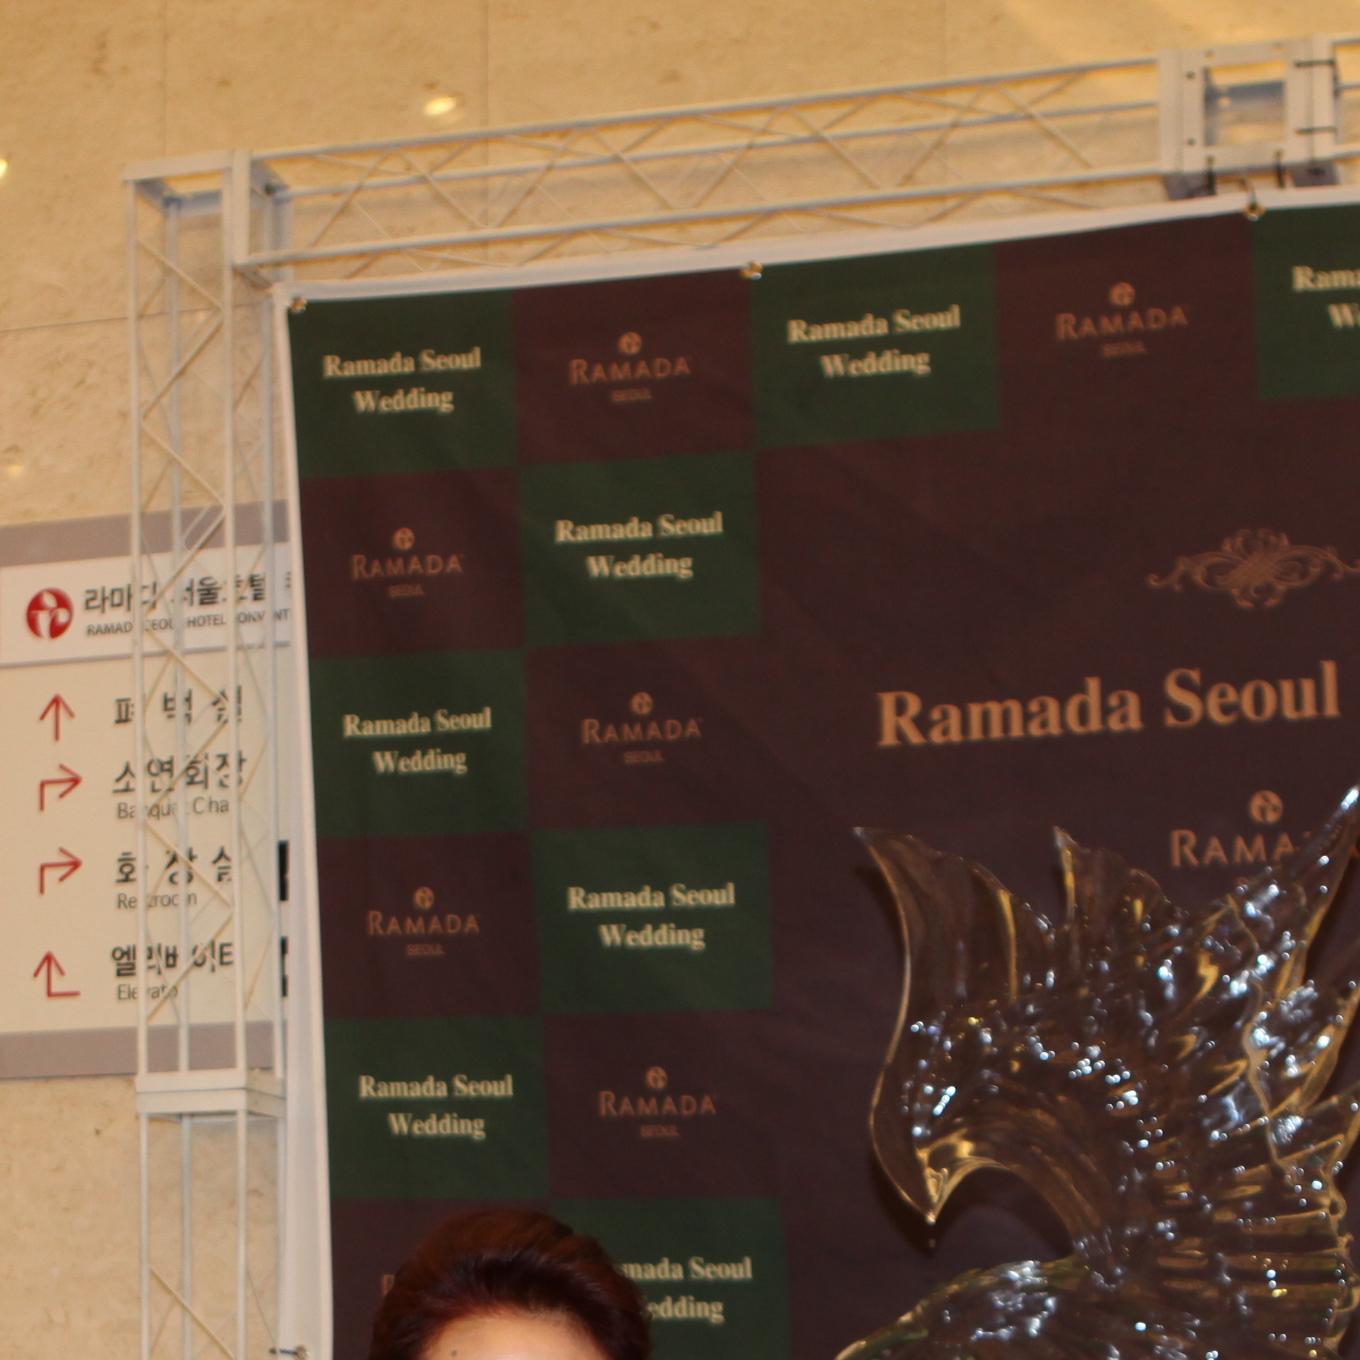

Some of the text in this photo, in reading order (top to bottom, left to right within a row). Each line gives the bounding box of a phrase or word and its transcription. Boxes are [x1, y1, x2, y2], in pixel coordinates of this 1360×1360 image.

[788, 305, 960, 343] Ramada Seoul
[1056, 306, 1187, 340] RAMADA
[324, 347, 481, 377] Ramada Seoul
[570, 357, 690, 384] RAMADA
[821, 349, 930, 376] Wedding
[354, 387, 454, 413] Wedding
[556, 511, 723, 543] Ramada Seoul
[352, 554, 462, 579] RAMADA
[587, 553, 693, 579] Wedding
[86, 621, 134, 636] RAMAD
[187, 613, 227, 628] HOTEL
[879, 677, 1143, 746] Ramada
[1165, 661, 1339, 726] Seoul
[343, 707, 491, 737] Ramada Seoul
[582, 718, 701, 744] RAMADA
[373, 749, 467, 774] Wedding
[1170, 829, 1359, 867] RAMA
[568, 883, 735, 910] Ramada Seoul
[368, 910, 479, 935] RAMADA
[600, 924, 705, 951] Wedding
[359, 1075, 513, 1098] Ramada Seoul
[599, 1091, 716, 1116] RAMADA
[389, 1113, 485, 1140] Wedding
[621, 1257, 752, 1280] mada Seoul
[646, 1296, 725, 1324] edding
